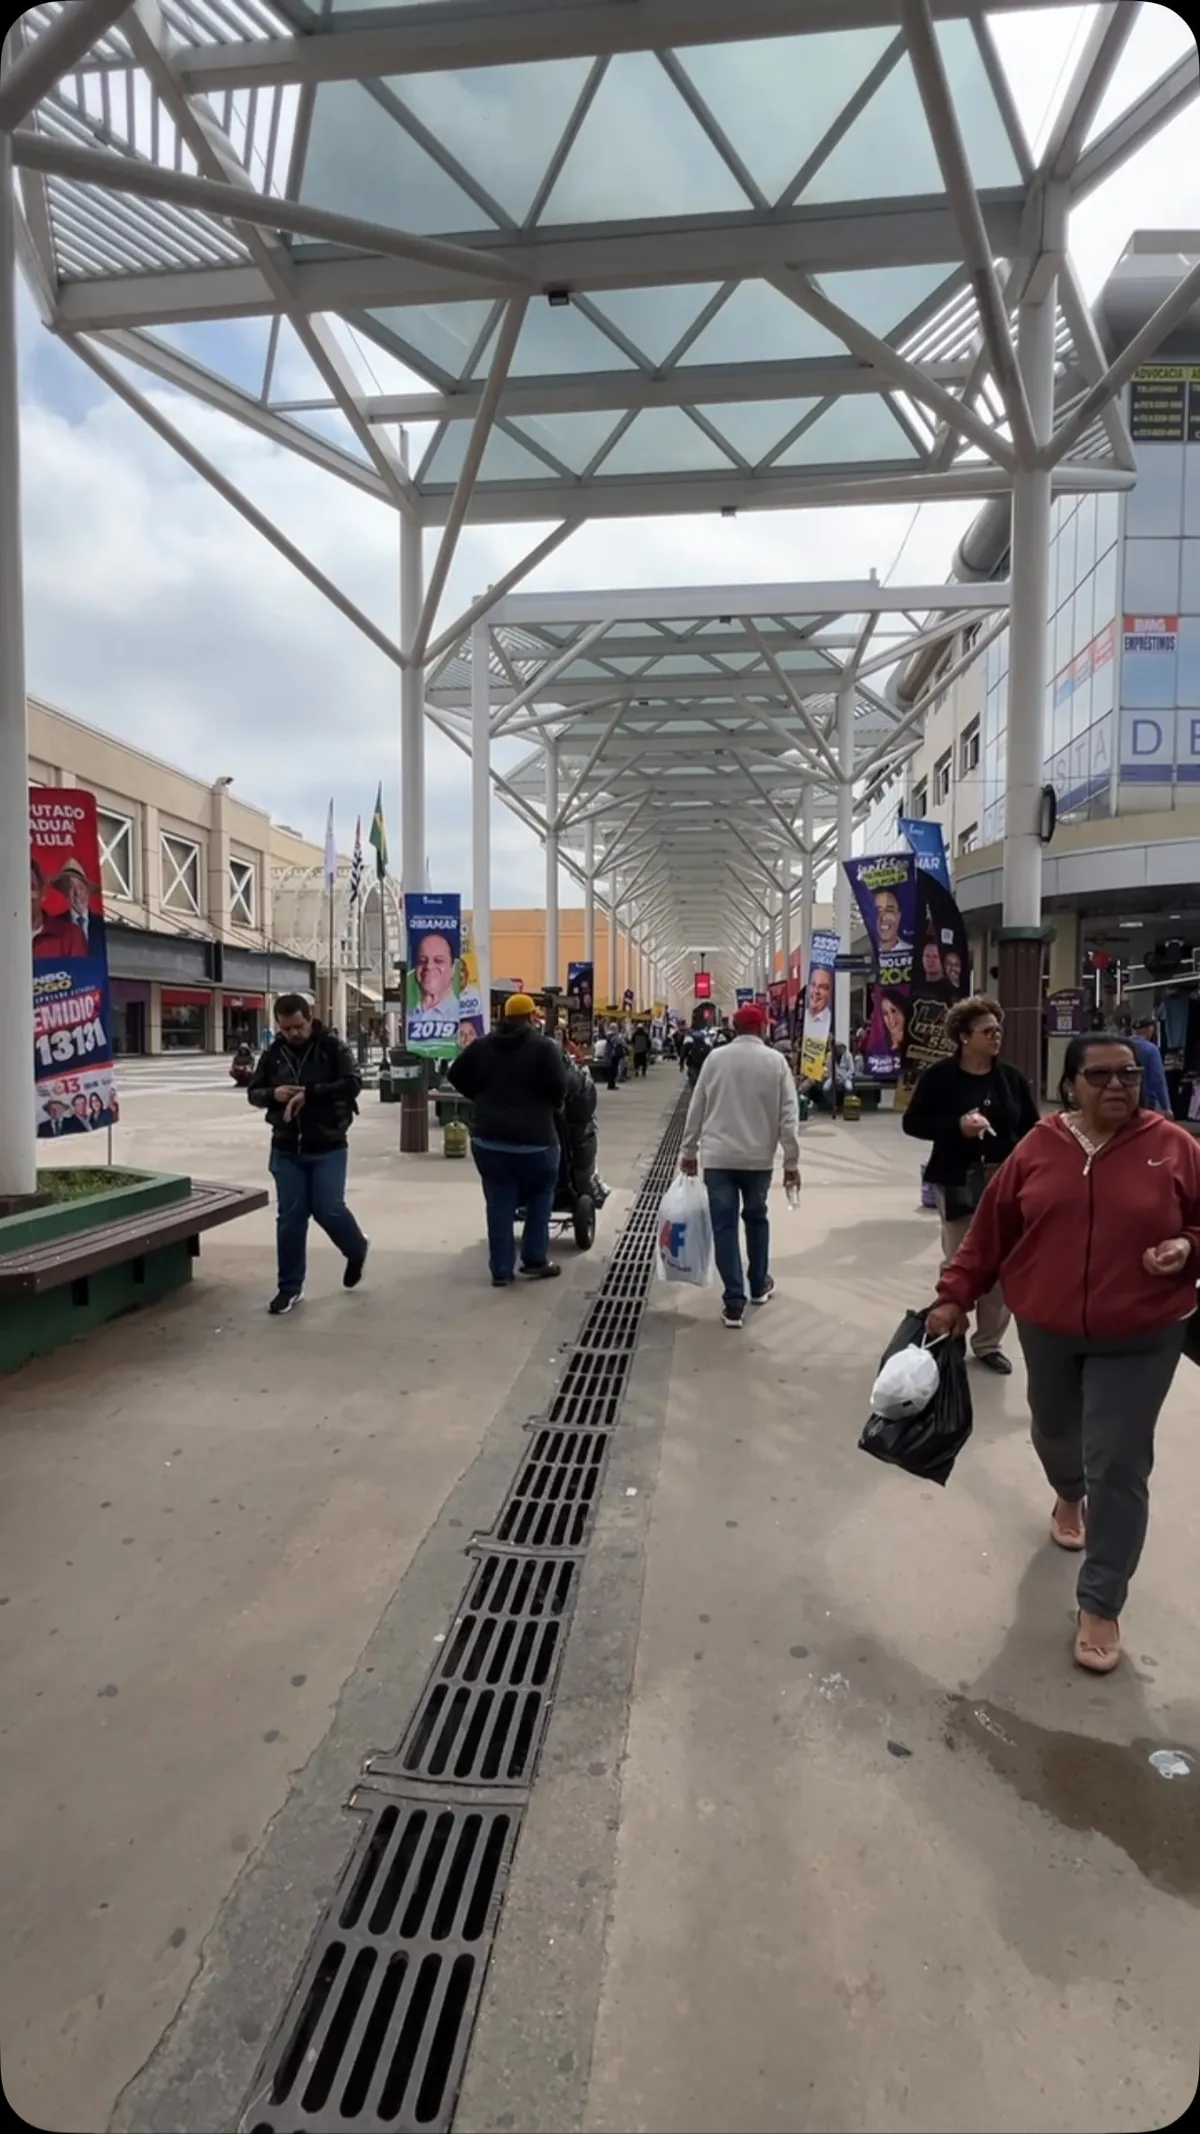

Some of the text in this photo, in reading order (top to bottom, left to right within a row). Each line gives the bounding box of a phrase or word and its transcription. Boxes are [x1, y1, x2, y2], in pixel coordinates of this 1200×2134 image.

[36, 833, 74, 847] LULA
[409, 1021, 456, 1038] 2019
[36, 1017, 107, 1066] 13131
